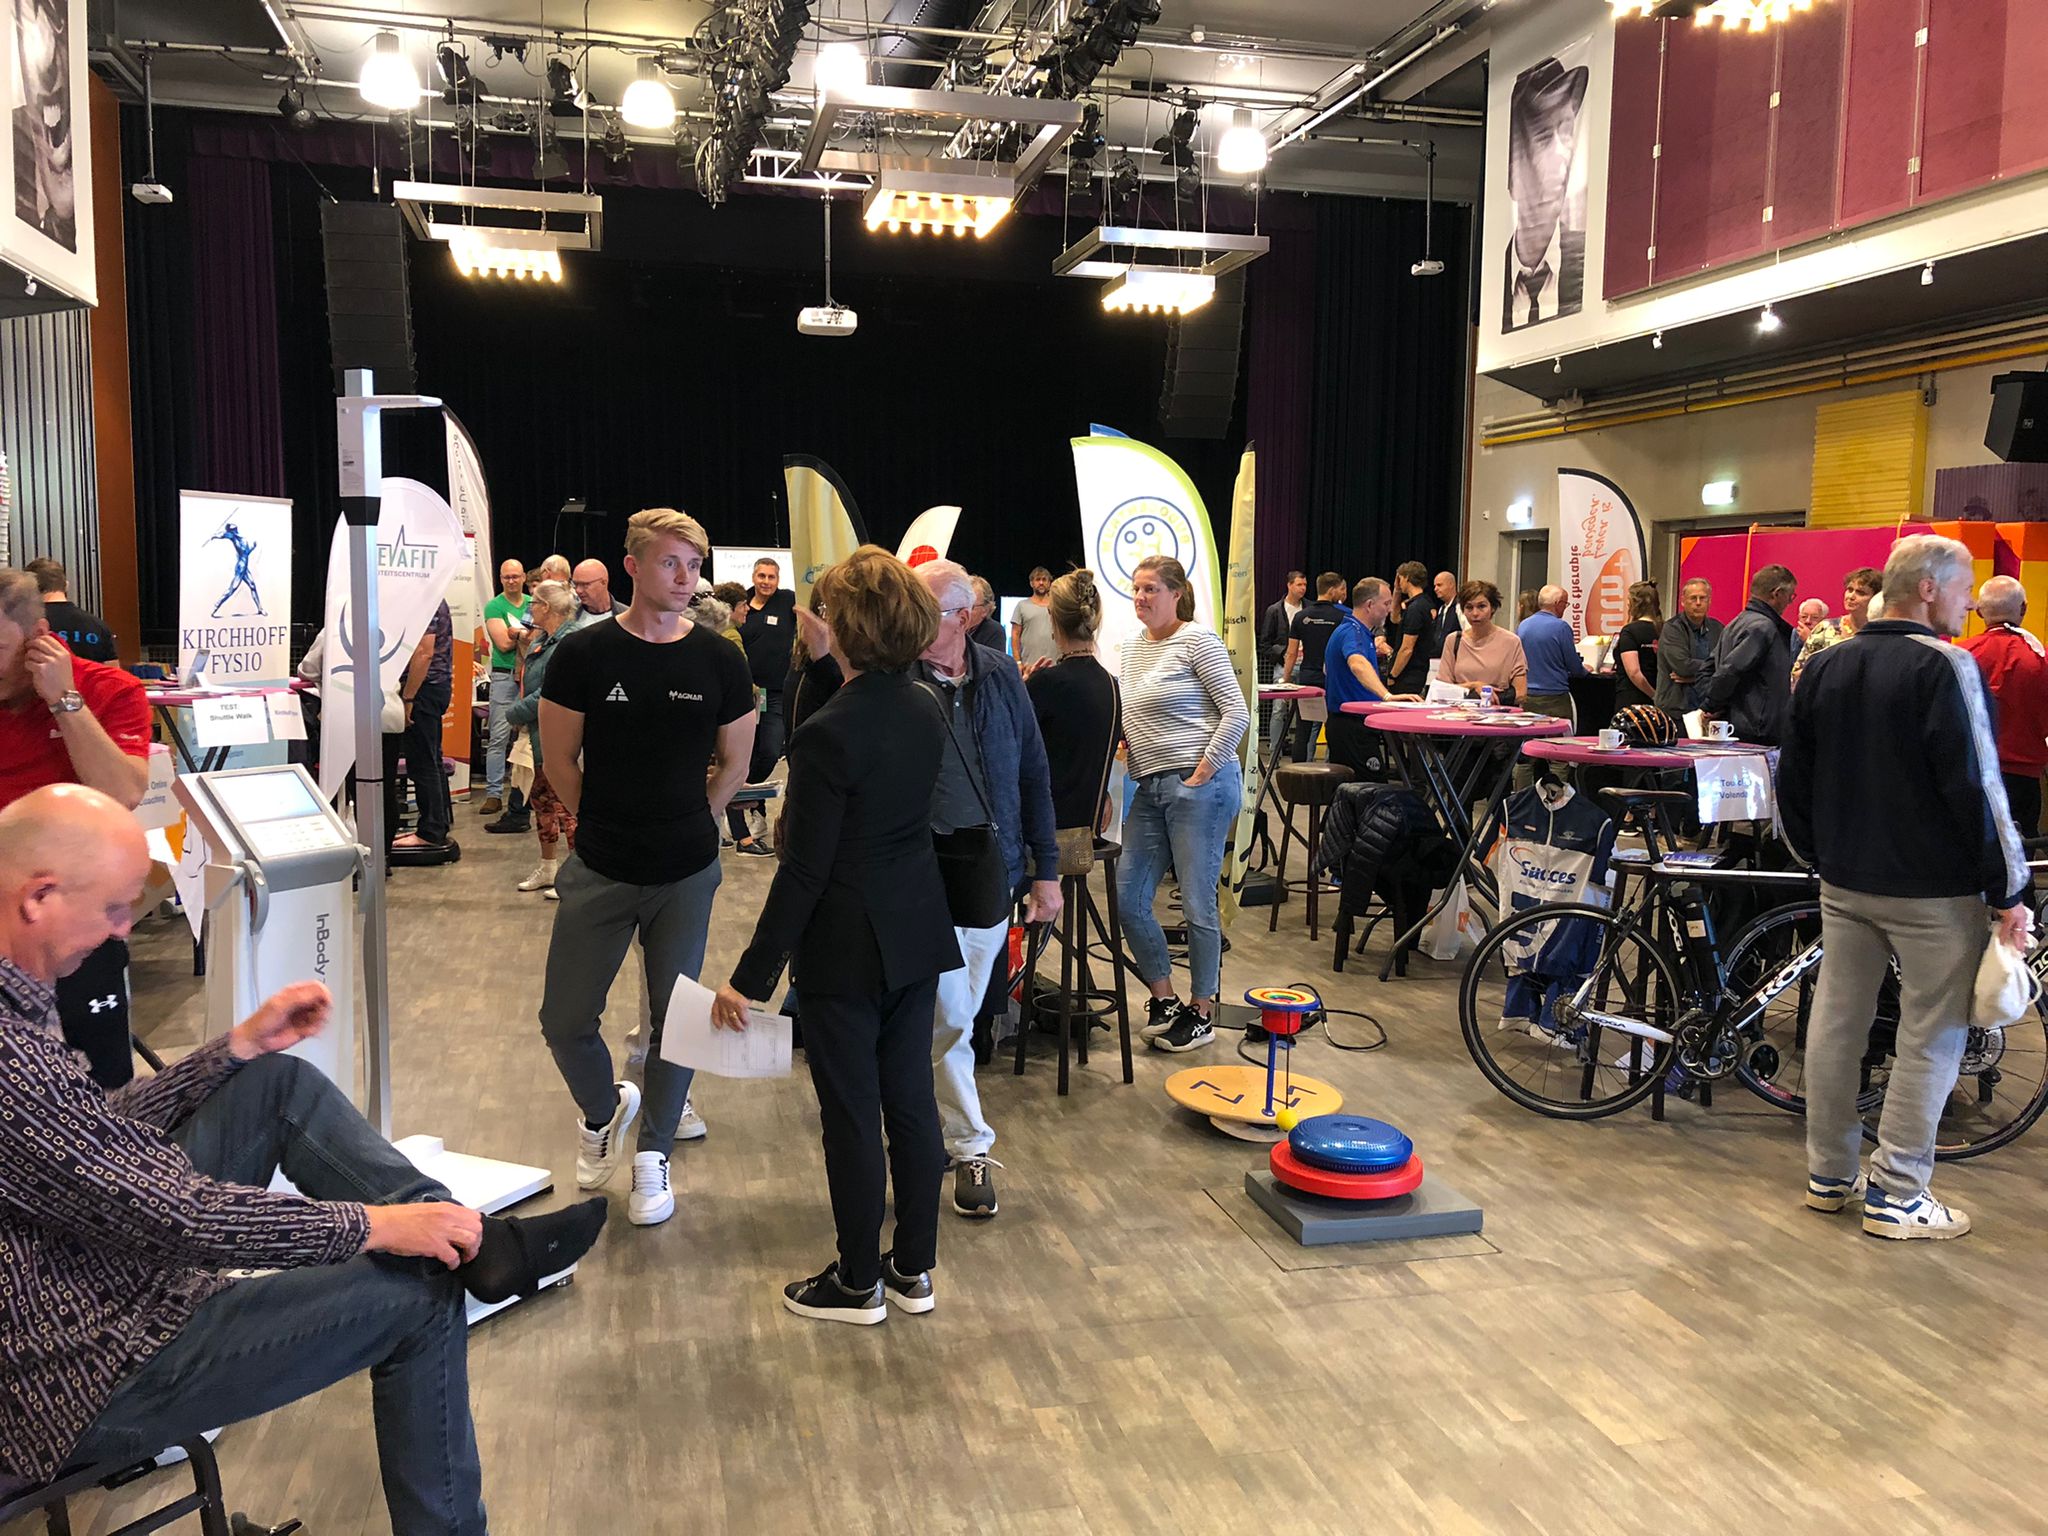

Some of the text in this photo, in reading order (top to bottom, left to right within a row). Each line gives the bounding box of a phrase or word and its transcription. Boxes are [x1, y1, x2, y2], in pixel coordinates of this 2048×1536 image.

[183, 625, 288, 650] KIRCHHOFF
[211, 652, 262, 674] FYSIO
[236, 712, 253, 720] Walk
[314, 913, 330, 976] InBody
[1754, 945, 1825, 1006] KOG
[1591, 1016, 1626, 1028] KOGA
